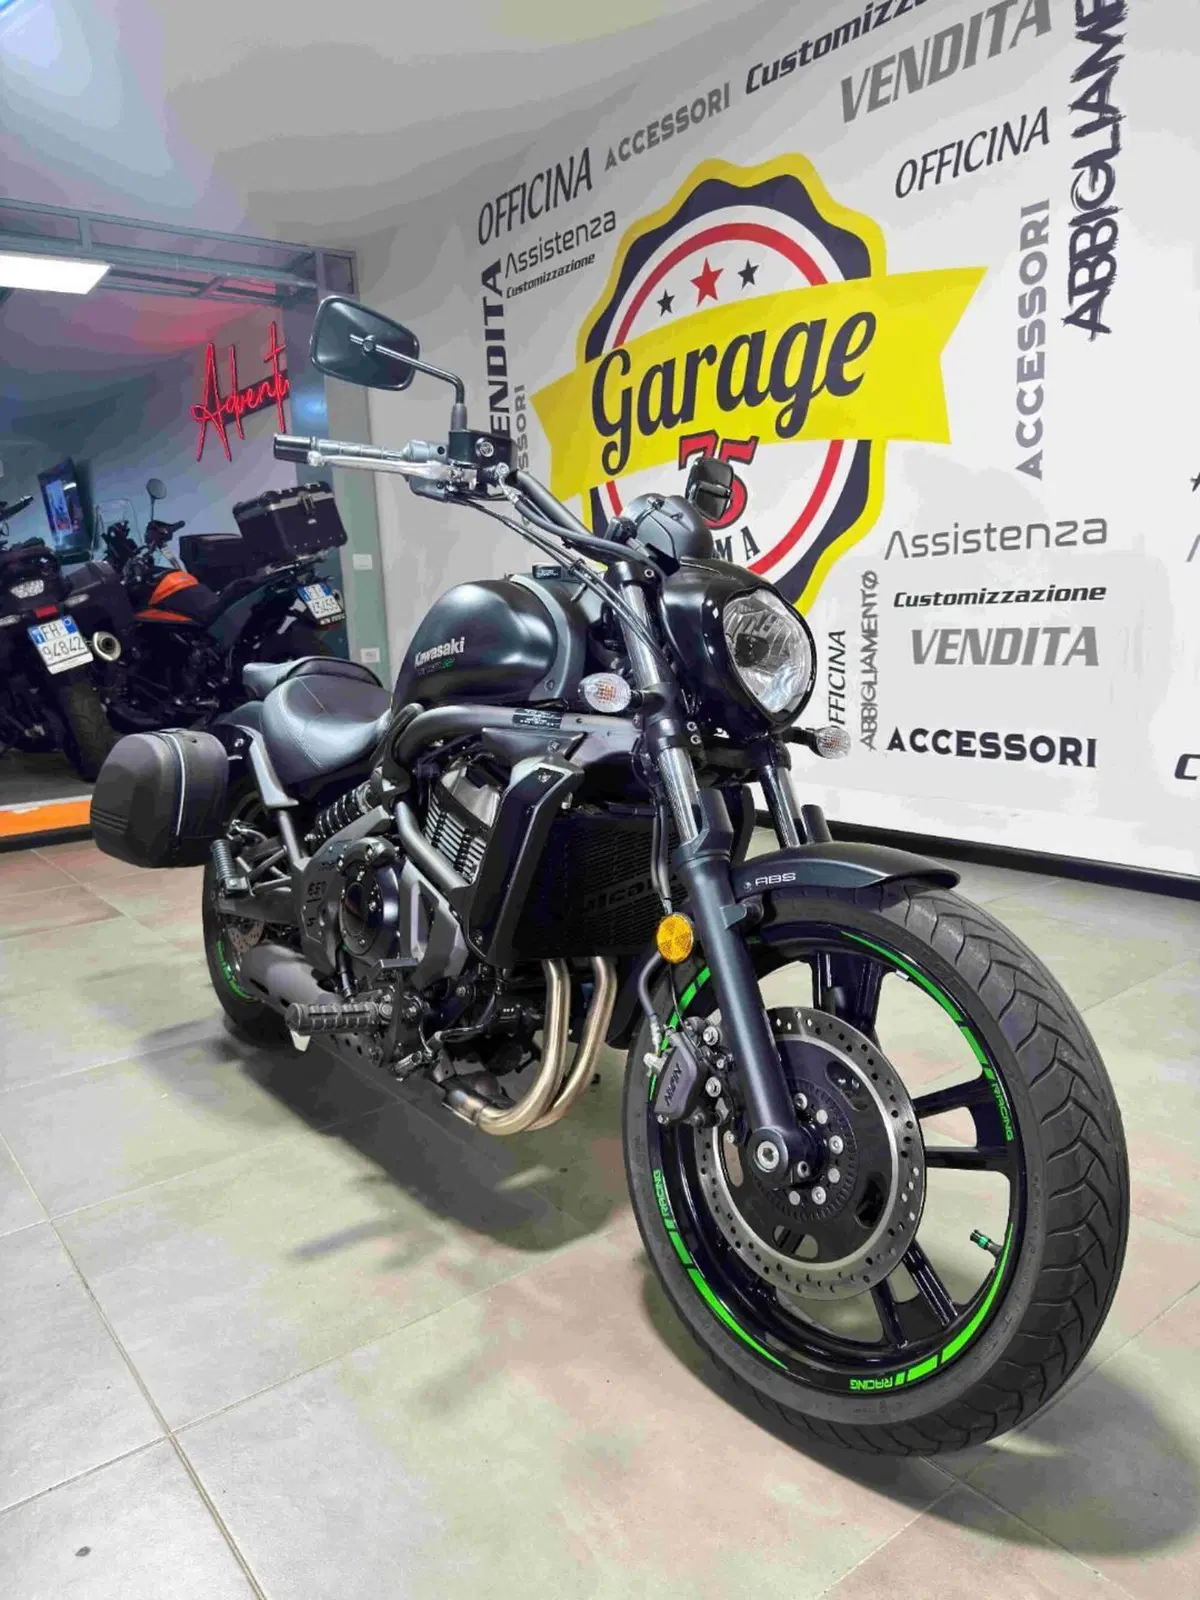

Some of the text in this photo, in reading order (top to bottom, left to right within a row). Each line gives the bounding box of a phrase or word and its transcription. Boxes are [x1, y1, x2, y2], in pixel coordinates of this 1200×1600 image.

[745, 0, 935, 95] Customizz
[839, 0, 1051, 123] VENDITA
[605, 82, 730, 171] ACCESSORI
[895, 106, 1050, 199] OFFICINA
[478, 147, 592, 246] OFFICINA
[505, 210, 616, 278] Assistenza
[506, 253, 595, 299] Customizzazione
[482, 258, 511, 438] ENDITA
[1015, 199, 1050, 480] ACCESSORI
[592, 311, 877, 475] Garage
[712, 526, 760, 562] MA
[885, 518, 1108, 560] Assistenza
[894, 585, 1107, 607] Customizzazione
[414, 636, 465, 668] Kawasaki
[828, 631, 846, 726] FFICINA
[860, 570, 879, 751] ABBIGLIAMENTO
[911, 627, 1099, 667] VENDITA
[887, 728, 1097, 767] ACCESSORI
[755, 872, 796, 887] ABS
[992, 1082, 1014, 1141] RACING
[850, 1376, 893, 1390] RACING
